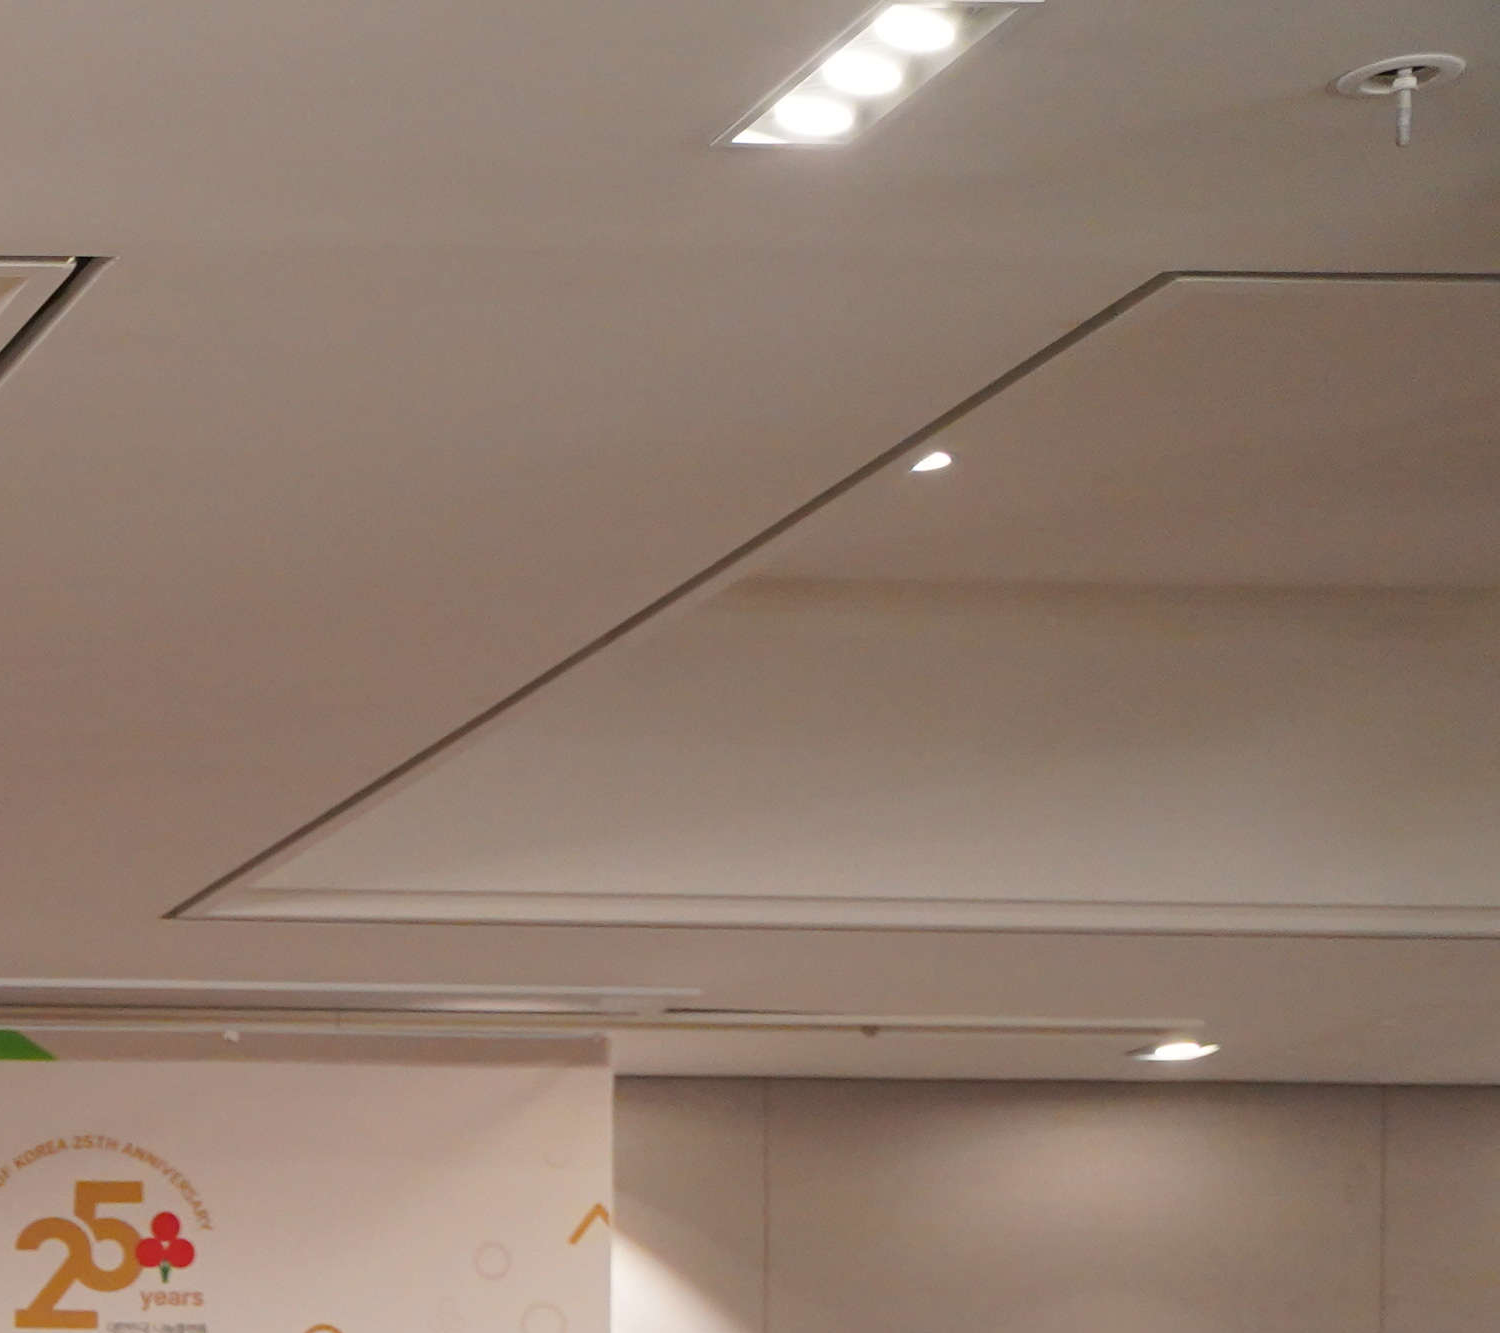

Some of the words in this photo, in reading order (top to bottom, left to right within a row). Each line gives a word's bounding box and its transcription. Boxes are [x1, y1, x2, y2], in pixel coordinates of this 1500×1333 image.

[13, 1138, 68, 1170] KOREA
[72, 1135, 119, 1150] 25TH
[122, 1142, 214, 1231] ANNIVERSARY
[14, 1181, 144, 1329] 25
[140, 1290, 204, 1311] years
